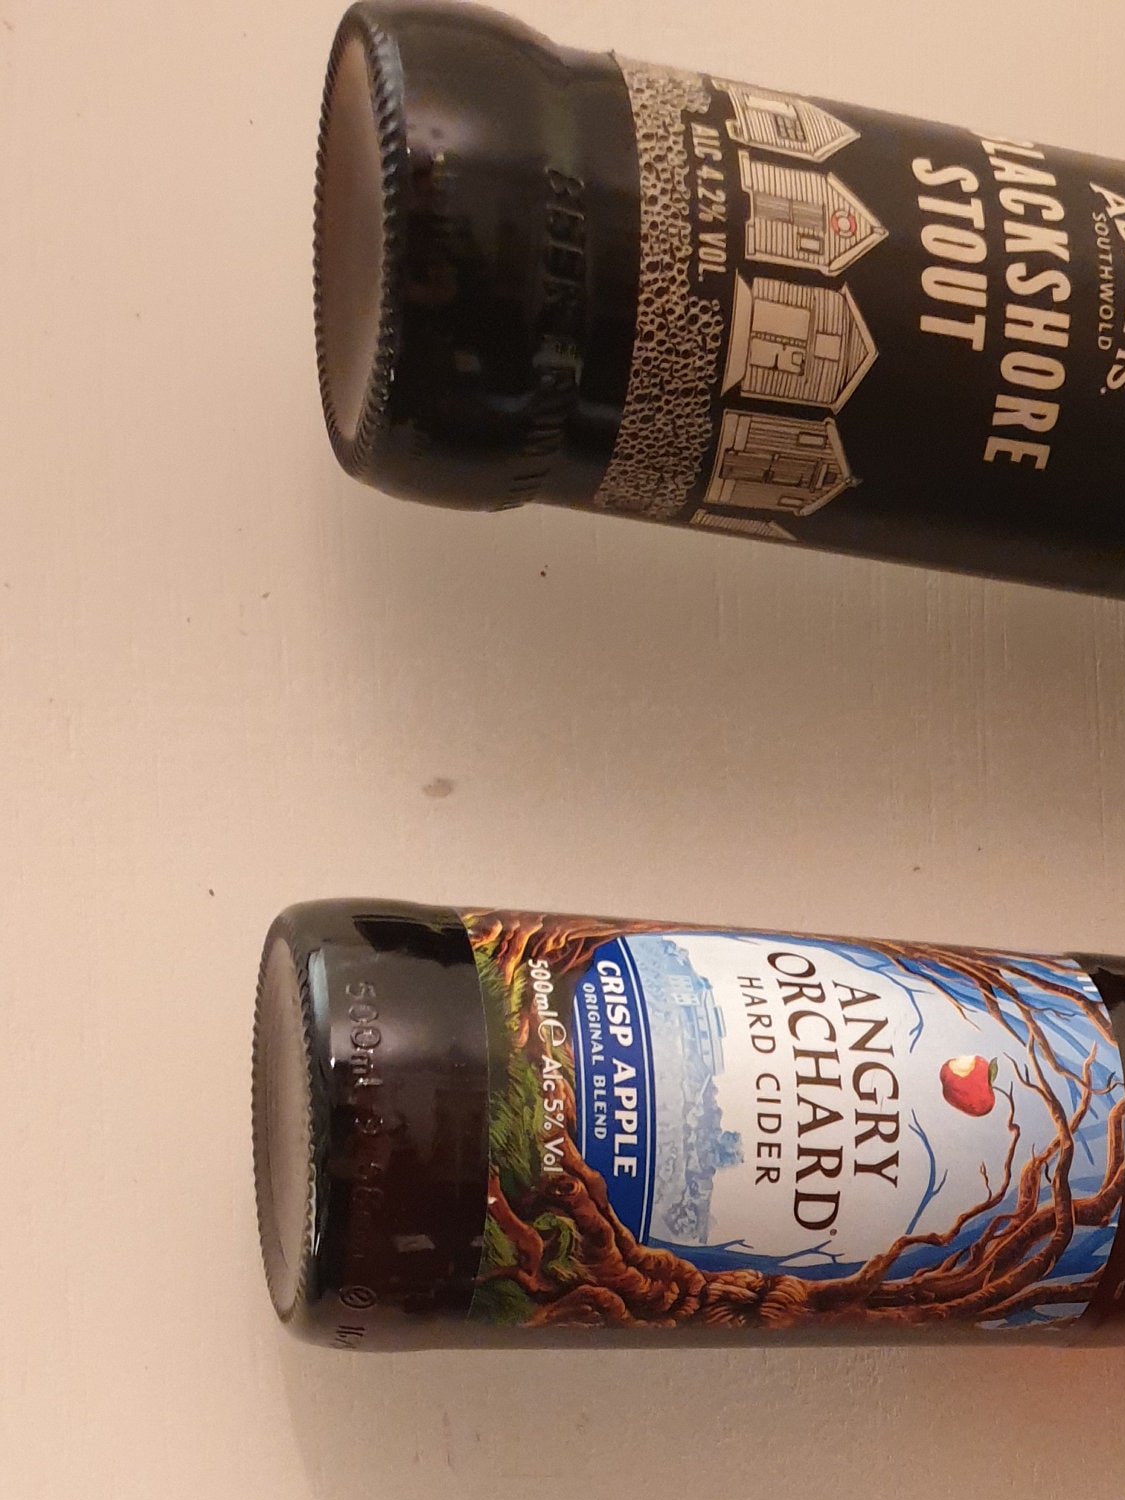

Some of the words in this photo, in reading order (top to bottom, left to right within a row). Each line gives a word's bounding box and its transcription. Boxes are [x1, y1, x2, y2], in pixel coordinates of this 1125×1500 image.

[690, 122, 721, 159] ALC
[693, 161, 727, 224] 4.2%
[697, 230, 728, 283] VOL.
[911, 156, 988, 352] STOUT
[1091, 211, 1114, 351] SOUTHWOLD
[980, 137, 1072, 471] LACKSHORE
[581, 982, 606, 1066] ORIGINAL
[596, 960, 633, 1048] CRISP
[736, 976, 776, 1055] HARD
[541, 1055, 563, 1091] Alc
[591, 1075, 607, 1141] BLEND
[766, 951, 844, 1233] ORCHARD
[834, 980, 900, 1189] ANGRY
[542, 1137, 565, 1175] Vol
[543, 1099, 566, 1132] 5%
[612, 1058, 638, 1178] APPLE
[754, 1073, 782, 1186] CIDER
